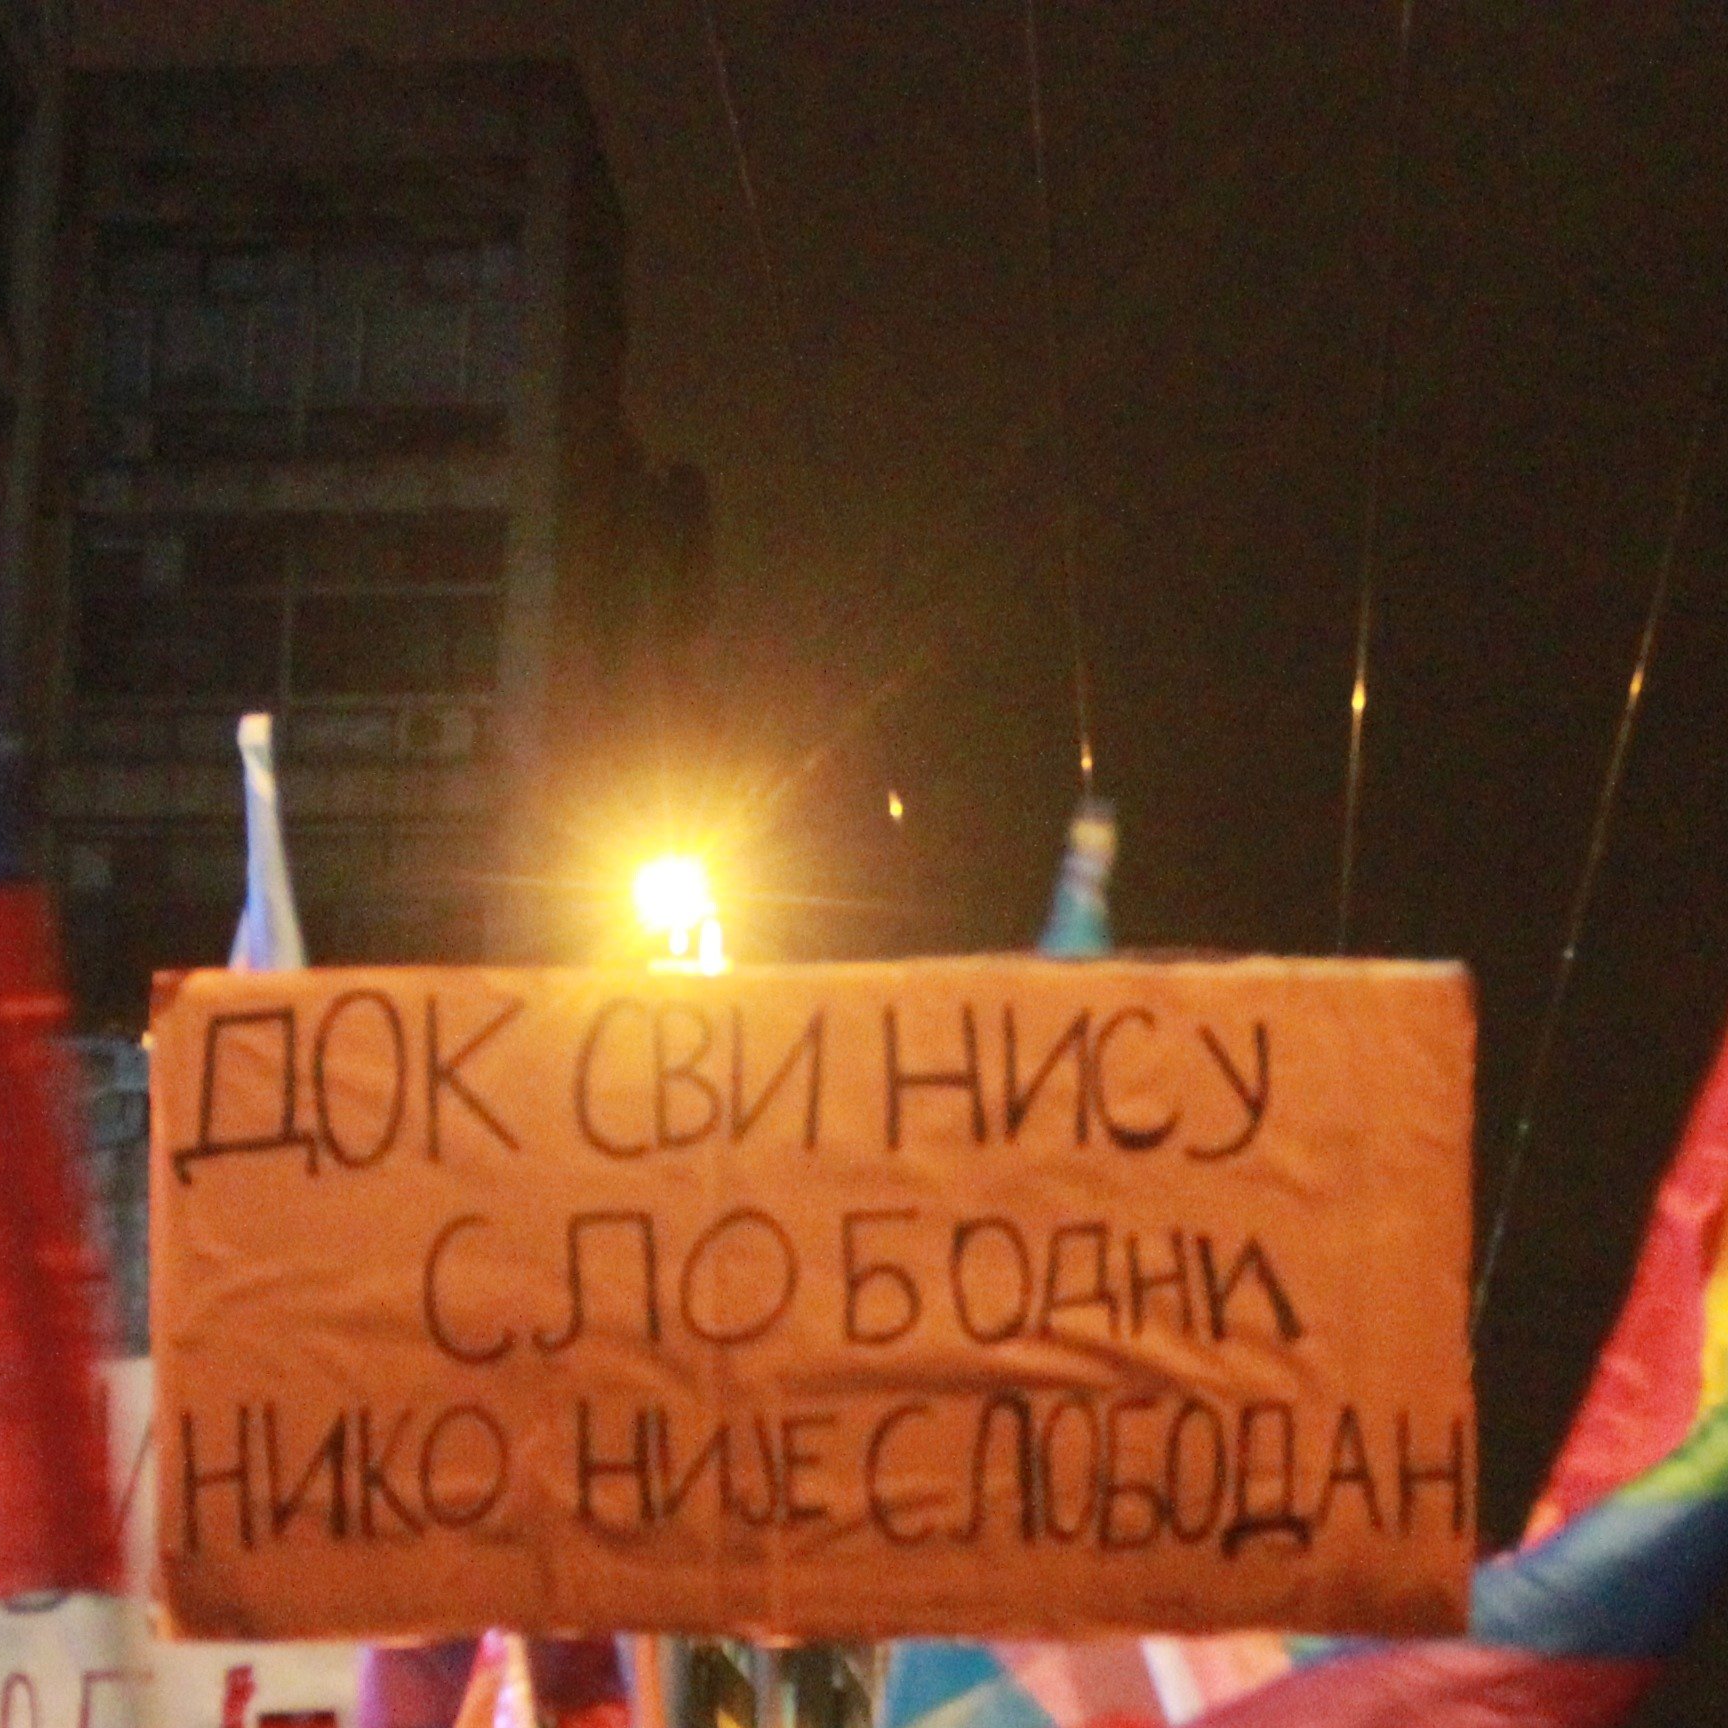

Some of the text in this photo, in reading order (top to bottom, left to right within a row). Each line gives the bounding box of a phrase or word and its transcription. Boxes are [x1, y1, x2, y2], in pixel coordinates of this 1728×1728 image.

[172, 988, 1270, 1184] ДОК СВИ НИСУ
[422, 1205, 1306, 1365] СЛОБОДНИ
[177, 1401, 512, 1556] НИКО
[576, 1400, 833, 1556] НИЈЕ
[869, 1393, 1468, 1560] СЛОБОДАН
